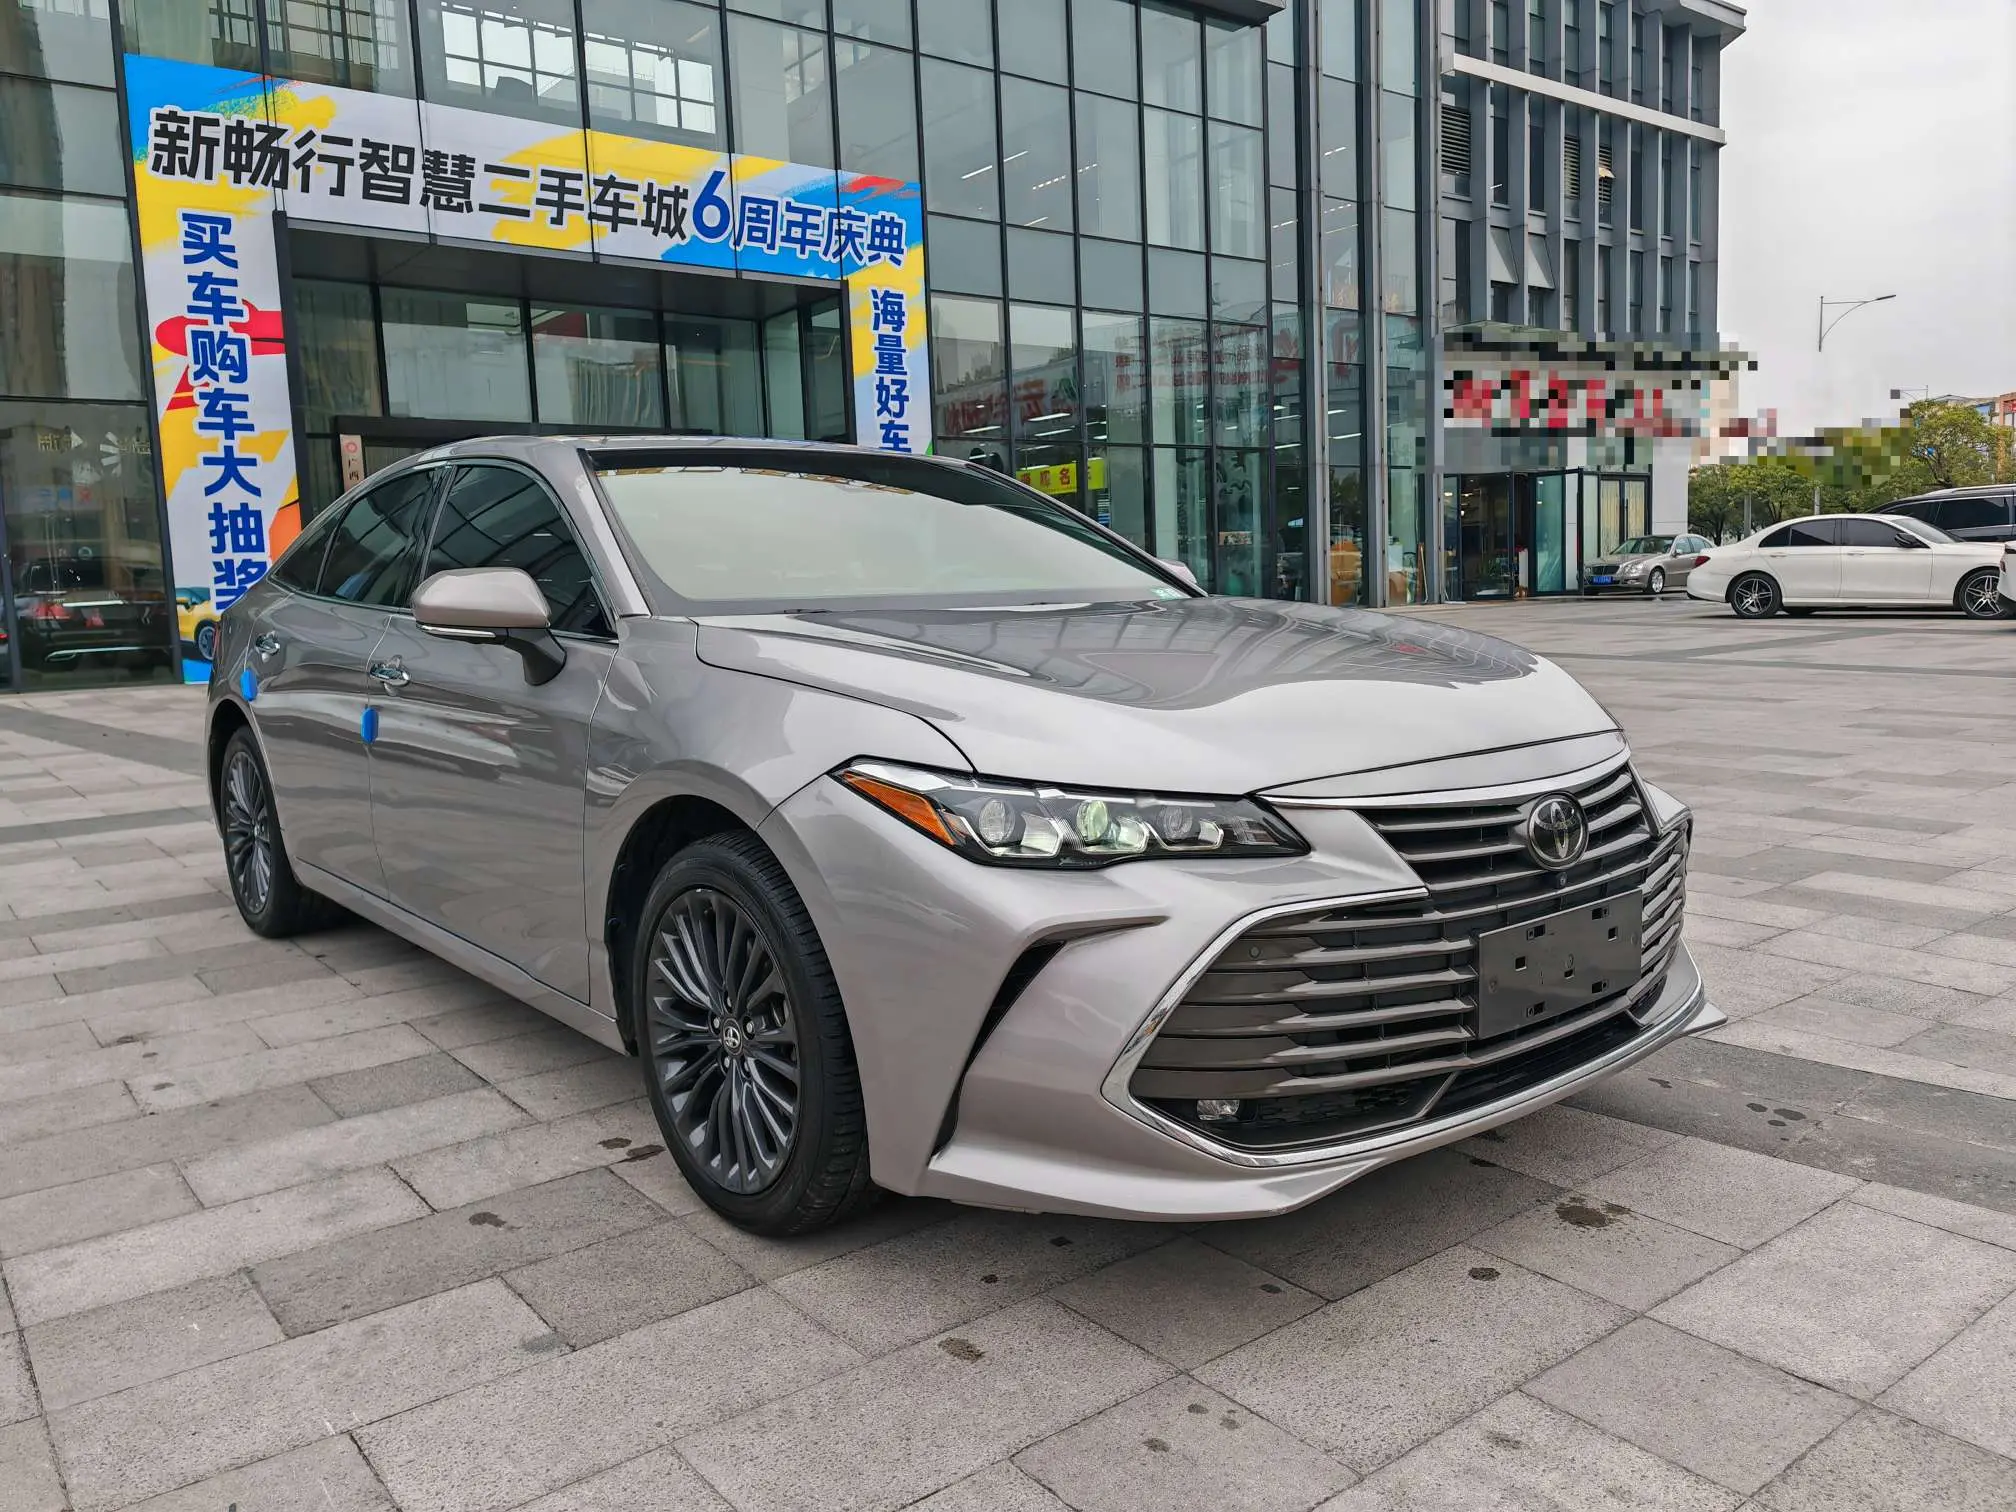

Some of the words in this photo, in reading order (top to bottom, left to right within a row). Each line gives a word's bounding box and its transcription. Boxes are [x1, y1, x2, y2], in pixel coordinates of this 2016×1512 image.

[152, 110, 904, 266] 新畅行智慧二手车城6周年庆典
[182, 213, 268, 610] 买车购车大抽奖
[870, 288, 911, 454] 海量好车
